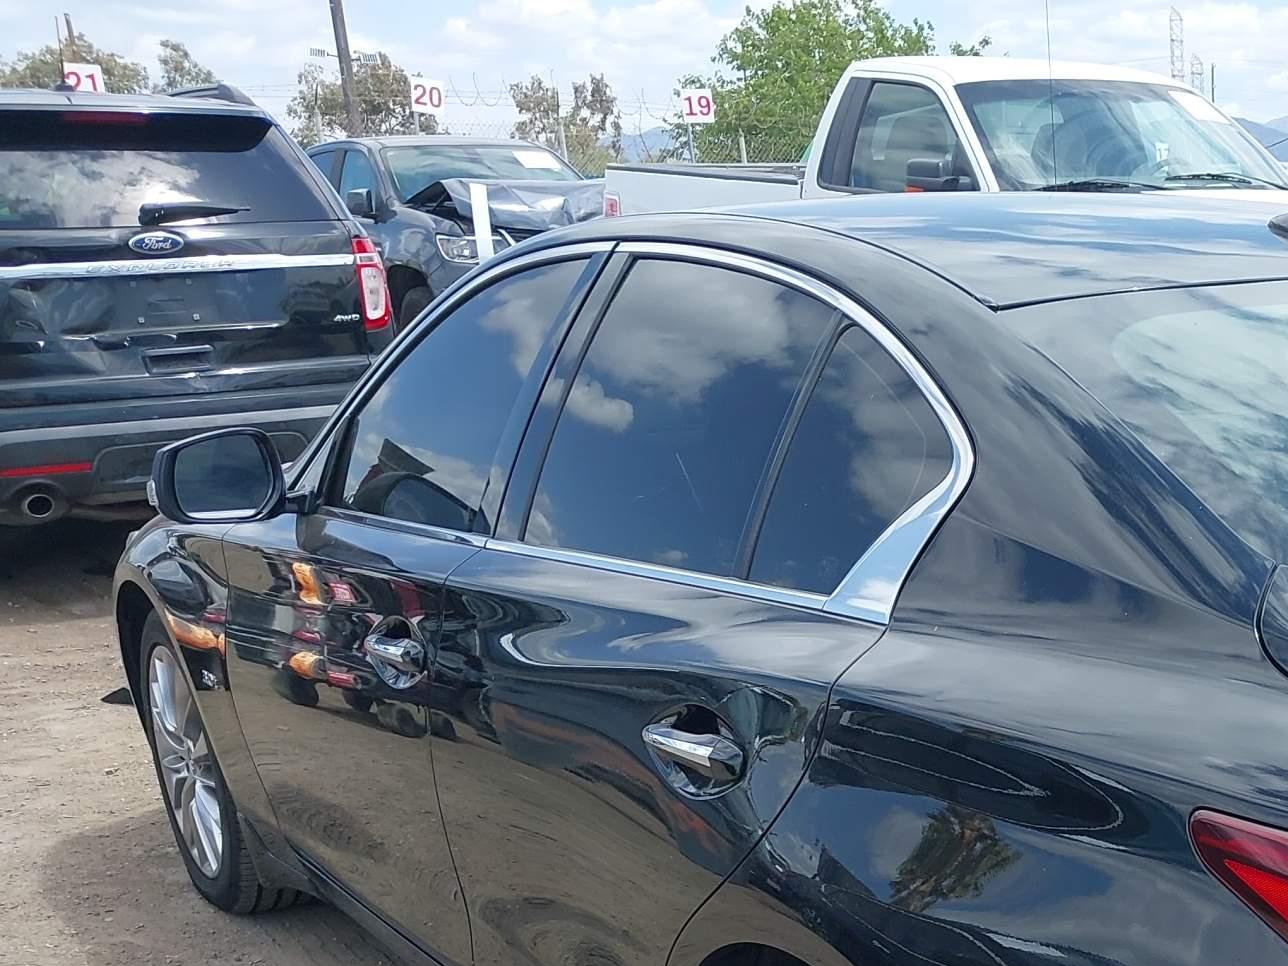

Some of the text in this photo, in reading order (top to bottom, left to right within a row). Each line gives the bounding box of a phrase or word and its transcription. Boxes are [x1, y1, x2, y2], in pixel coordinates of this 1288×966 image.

[413, 84, 442, 108] 20
[683, 95, 711, 116] 19
[142, 236, 173, 250] Ford
